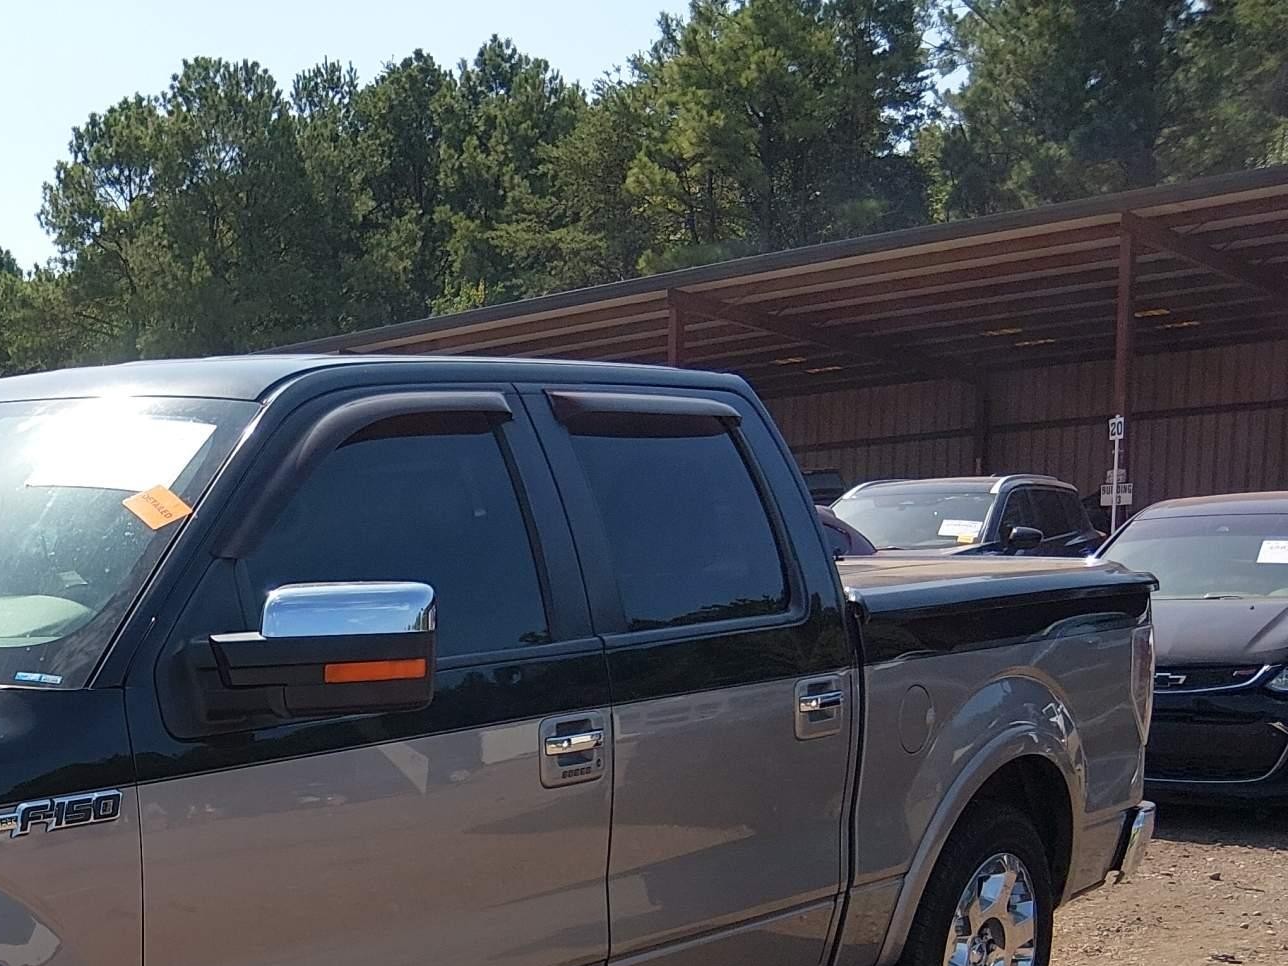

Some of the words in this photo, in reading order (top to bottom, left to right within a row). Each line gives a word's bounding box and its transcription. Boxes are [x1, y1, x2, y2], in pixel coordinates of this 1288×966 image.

[1110, 421, 1123, 436] 20
[1101, 484, 1132, 496] BUIDING
[142, 493, 173, 520] DETAILED
[14, 790, 123, 834] F-150
